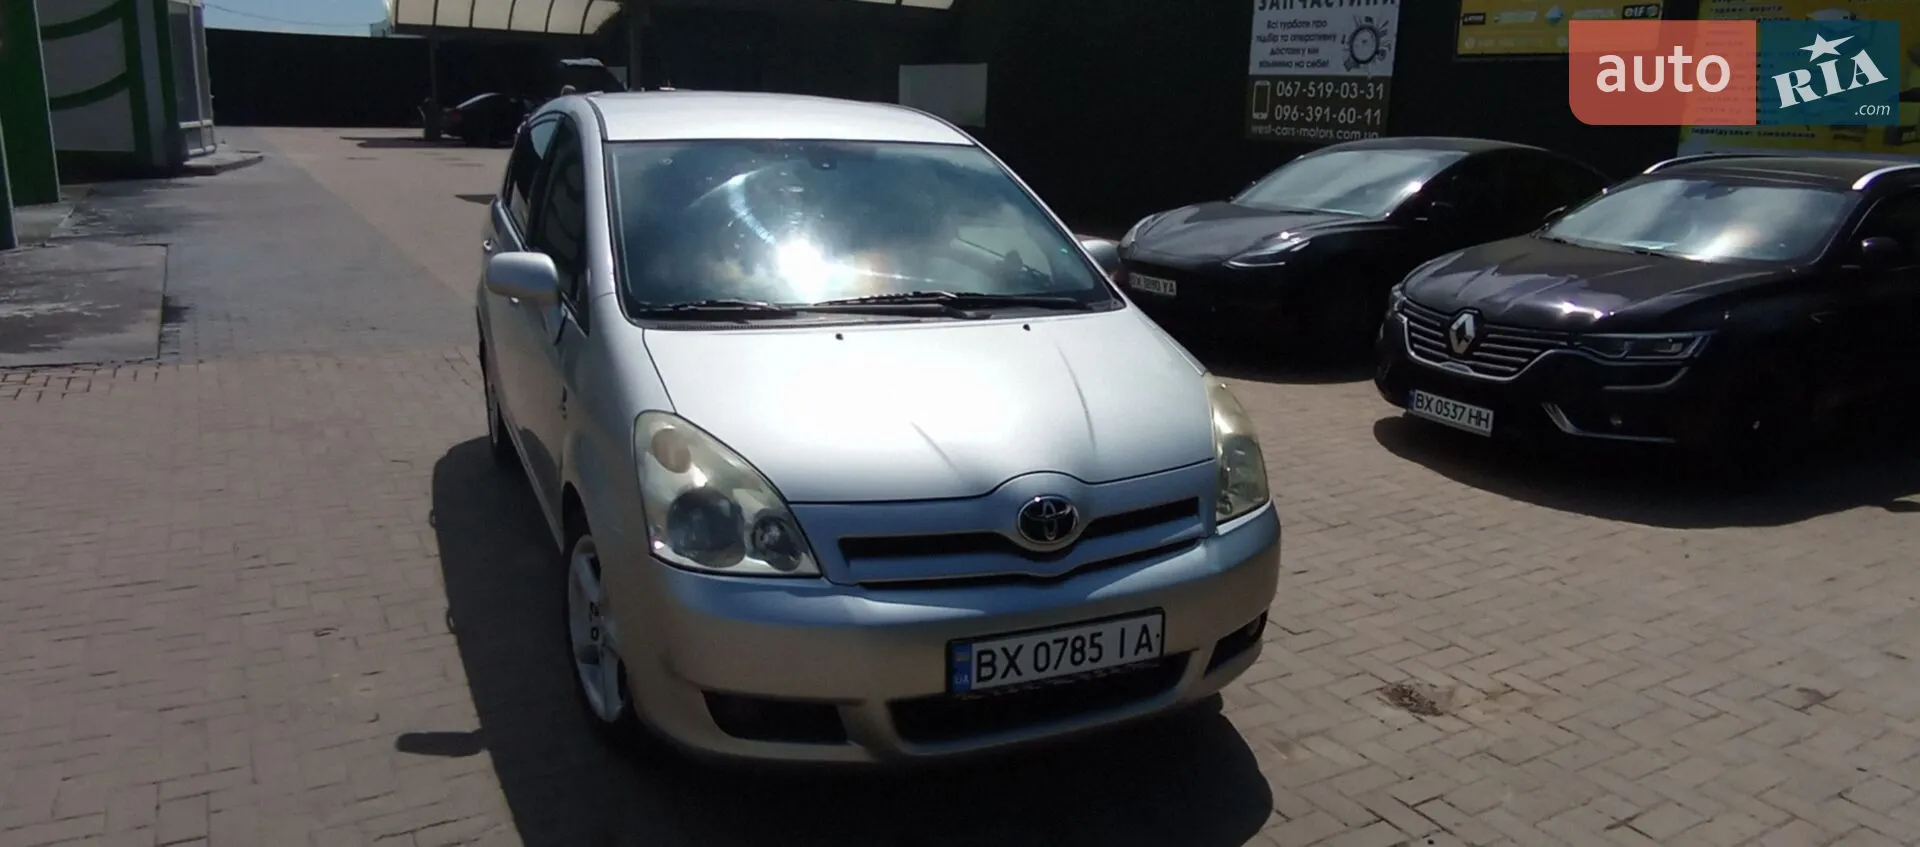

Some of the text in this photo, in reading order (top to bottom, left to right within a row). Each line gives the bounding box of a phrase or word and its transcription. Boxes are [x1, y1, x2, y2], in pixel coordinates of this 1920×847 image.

[1276, 81, 1384, 100] 067-519-03-31
[1274, 104, 1381, 126] 096-391-60-11
[1415, 393, 1490, 429] BX 0537 HH
[976, 623, 1153, 683] BX 0785 IA
